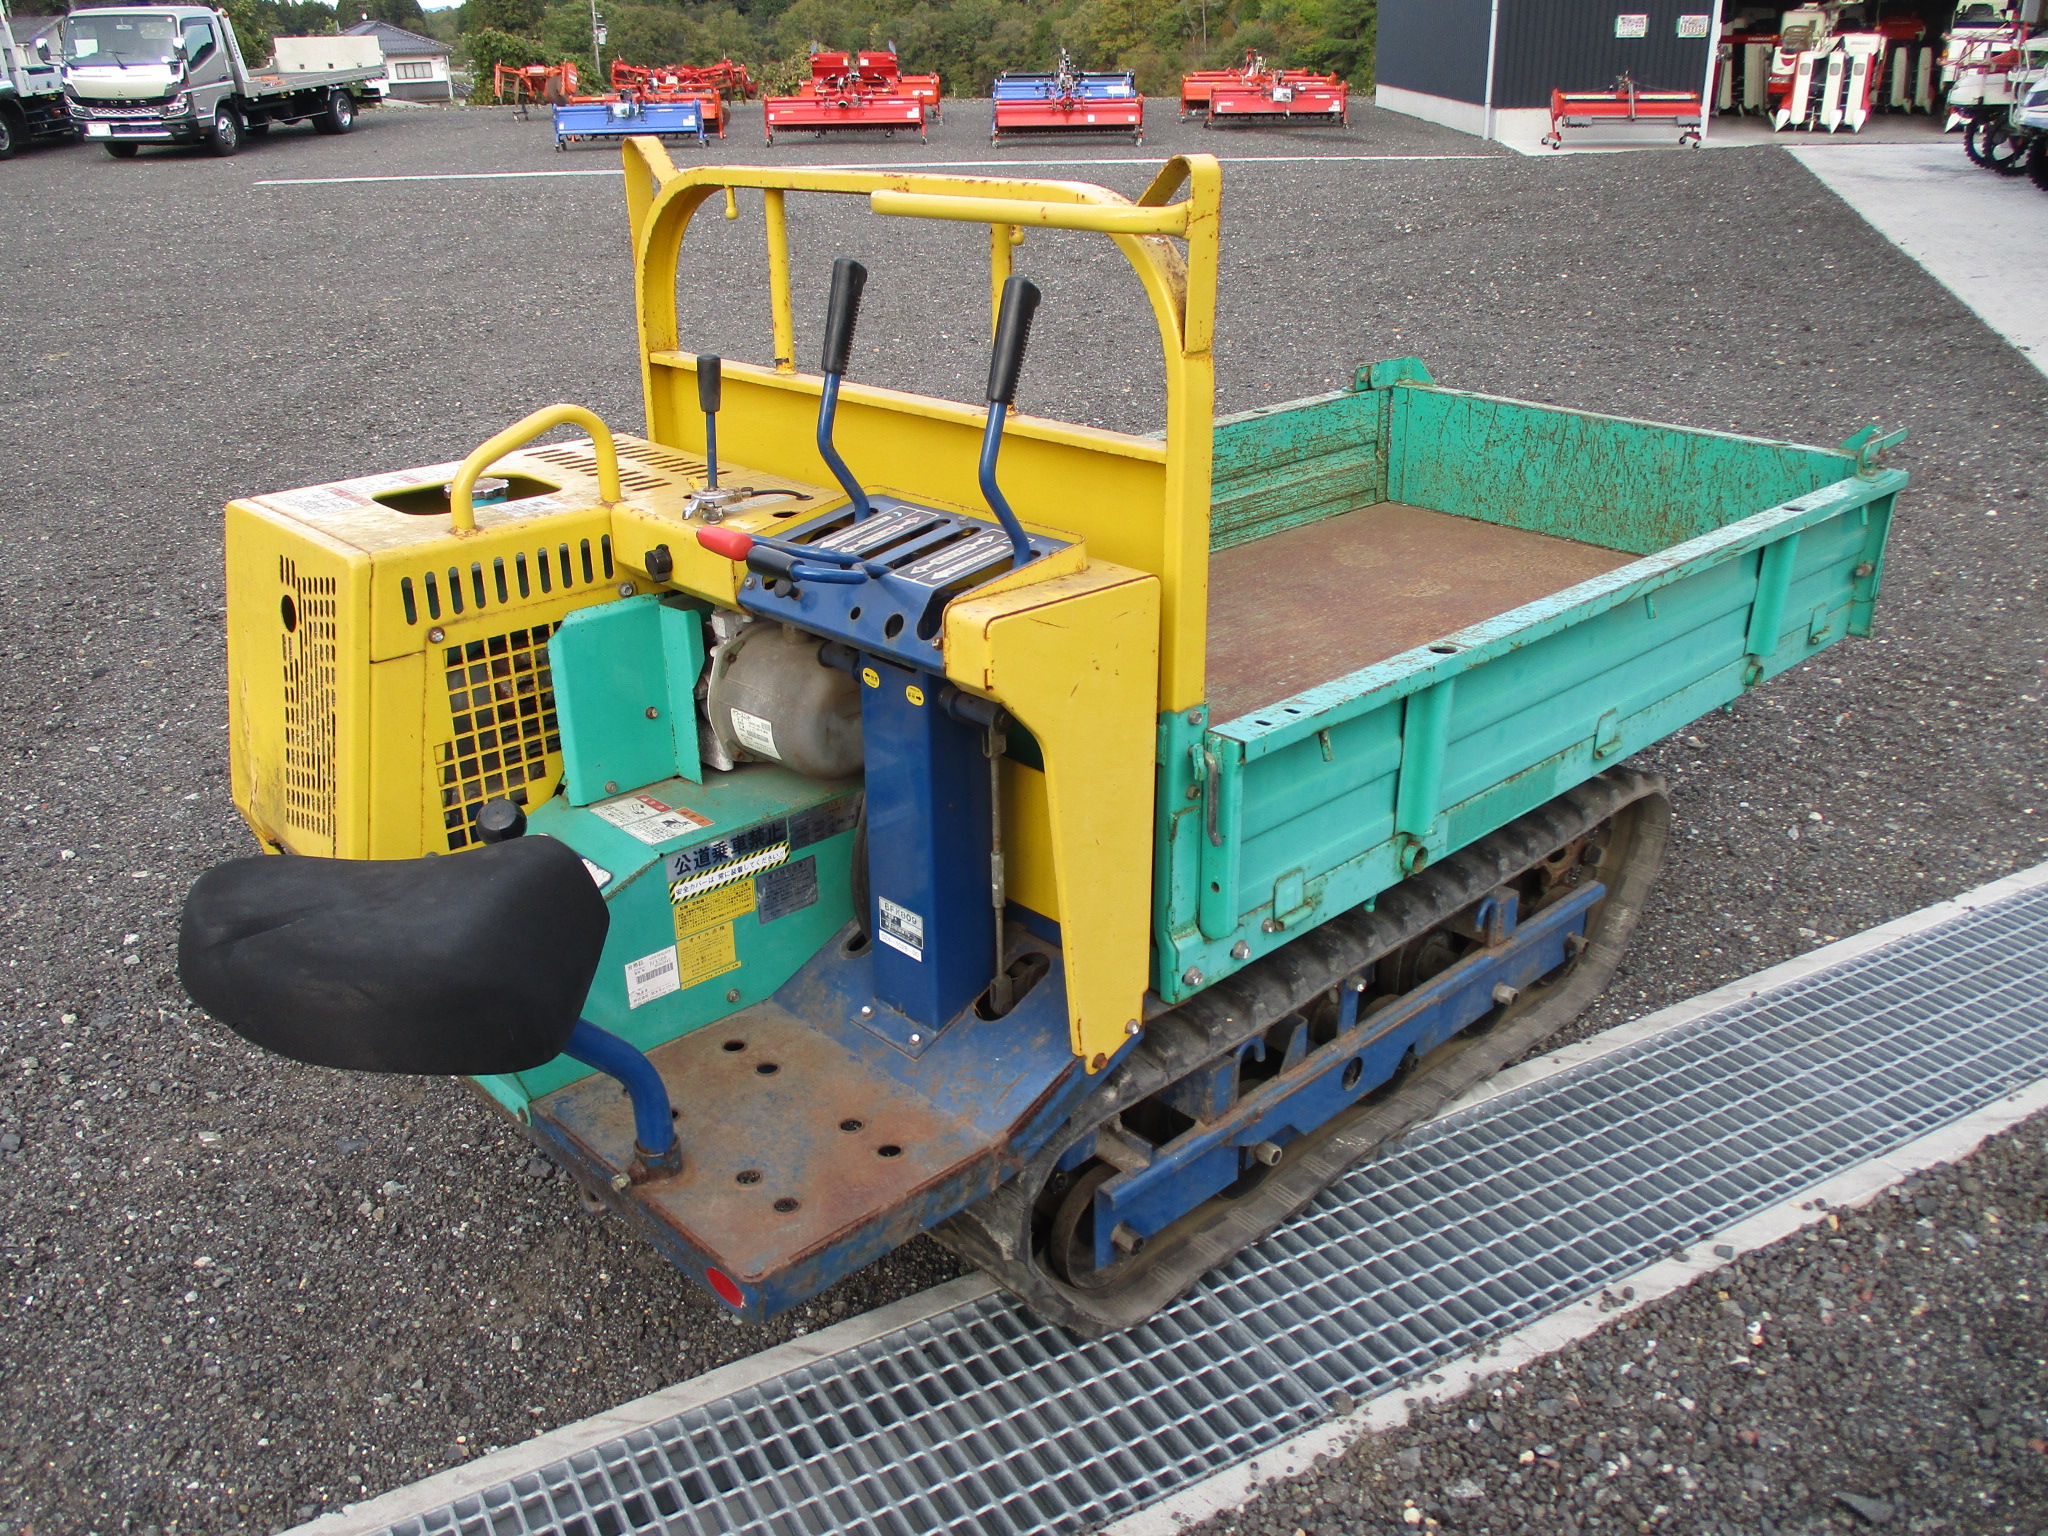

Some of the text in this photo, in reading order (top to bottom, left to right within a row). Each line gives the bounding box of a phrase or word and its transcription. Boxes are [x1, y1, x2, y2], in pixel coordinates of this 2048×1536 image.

[674, 822, 783, 876] 公道乗車禁止
